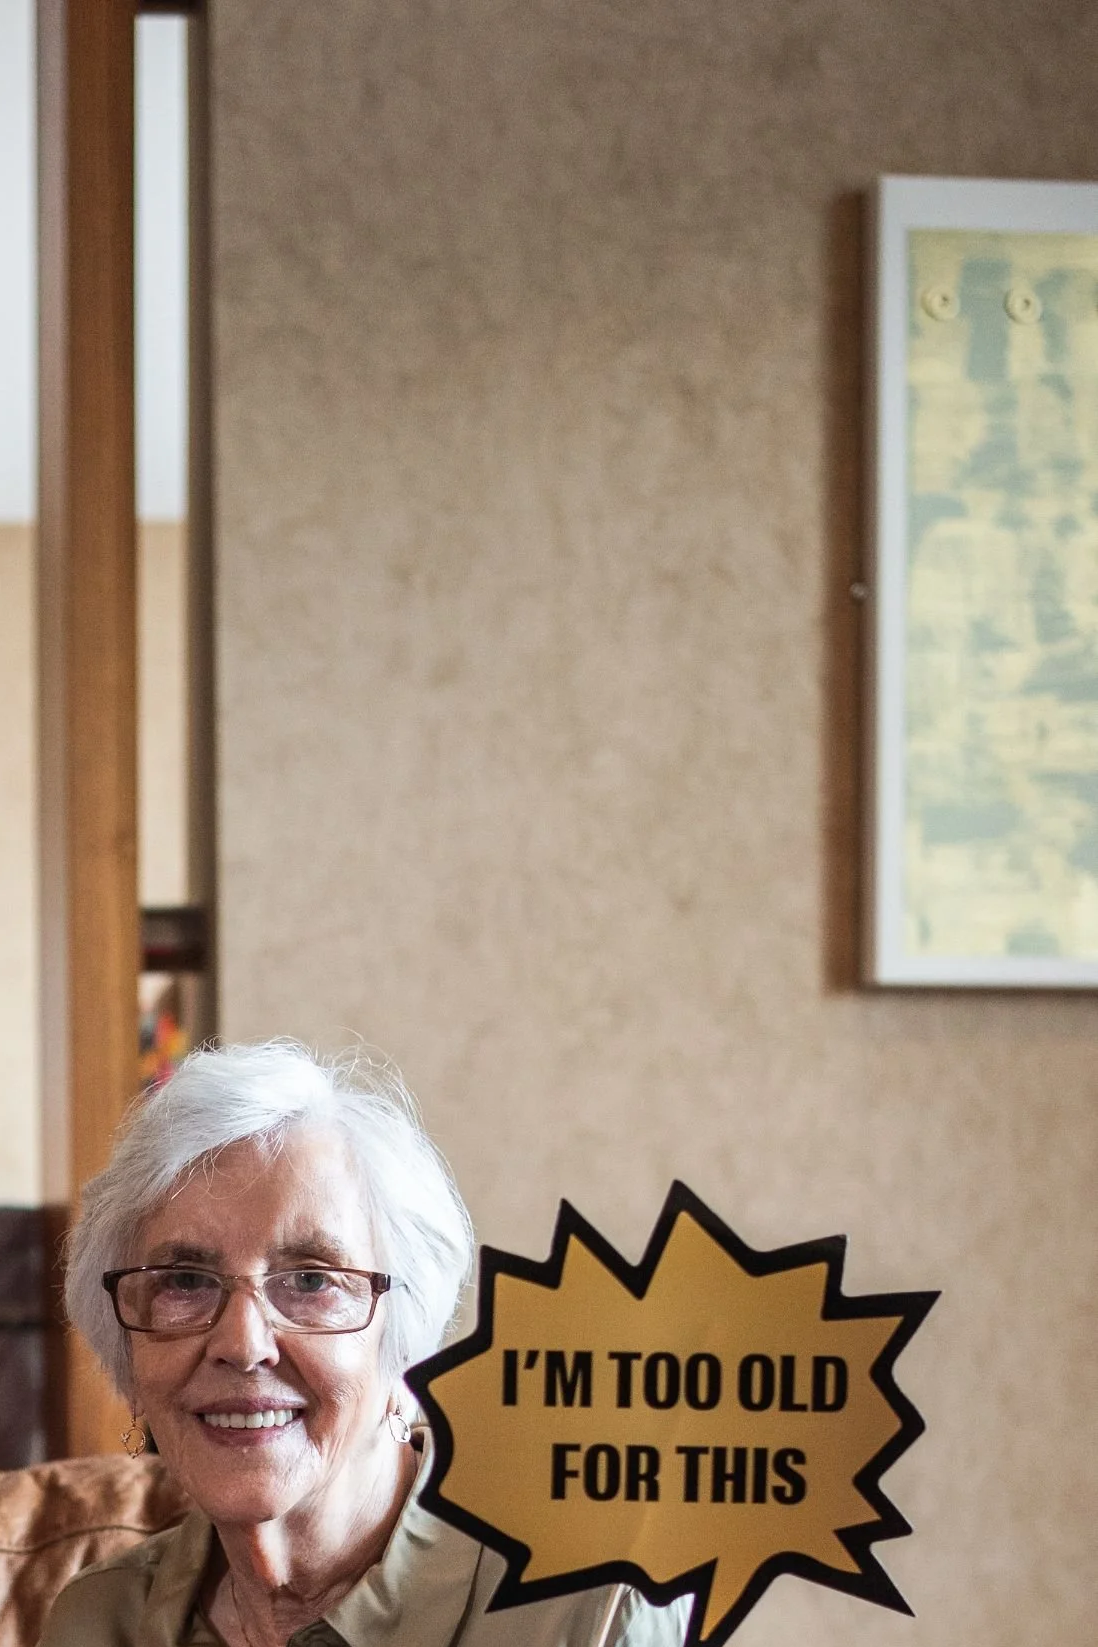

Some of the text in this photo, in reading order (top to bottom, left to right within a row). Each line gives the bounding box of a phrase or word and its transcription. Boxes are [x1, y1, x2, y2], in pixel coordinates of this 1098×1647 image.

[502, 1349, 849, 1414] I'M TOO OLD
[550, 1443, 808, 1506] FOR THIS
